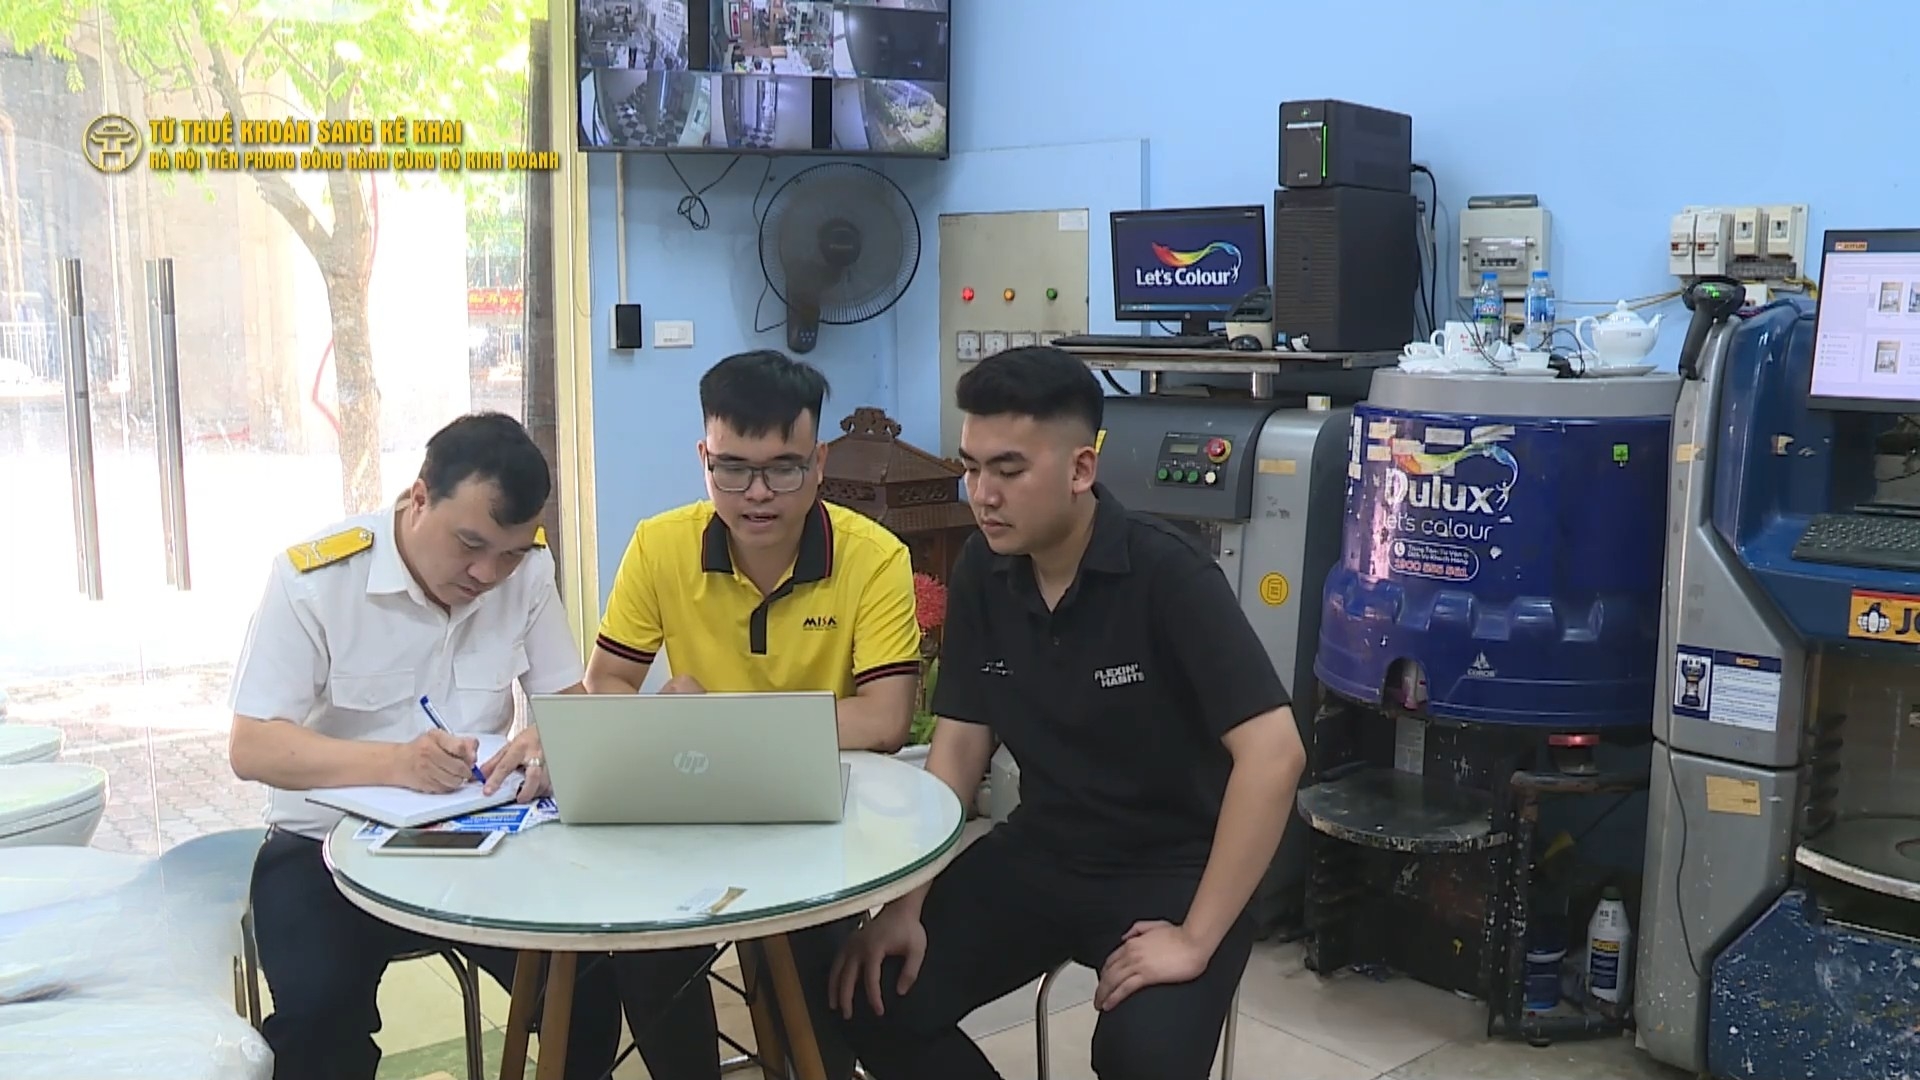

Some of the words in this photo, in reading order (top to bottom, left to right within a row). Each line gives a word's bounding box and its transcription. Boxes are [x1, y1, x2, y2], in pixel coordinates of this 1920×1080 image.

[1135, 267, 1173, 286] Let's
[1175, 267, 1232, 286] Colour
[1385, 467, 1495, 514] Dulux
[1421, 517, 1494, 541] colour
[803, 615, 837, 627] MISA
[673, 749, 709, 774] hp
